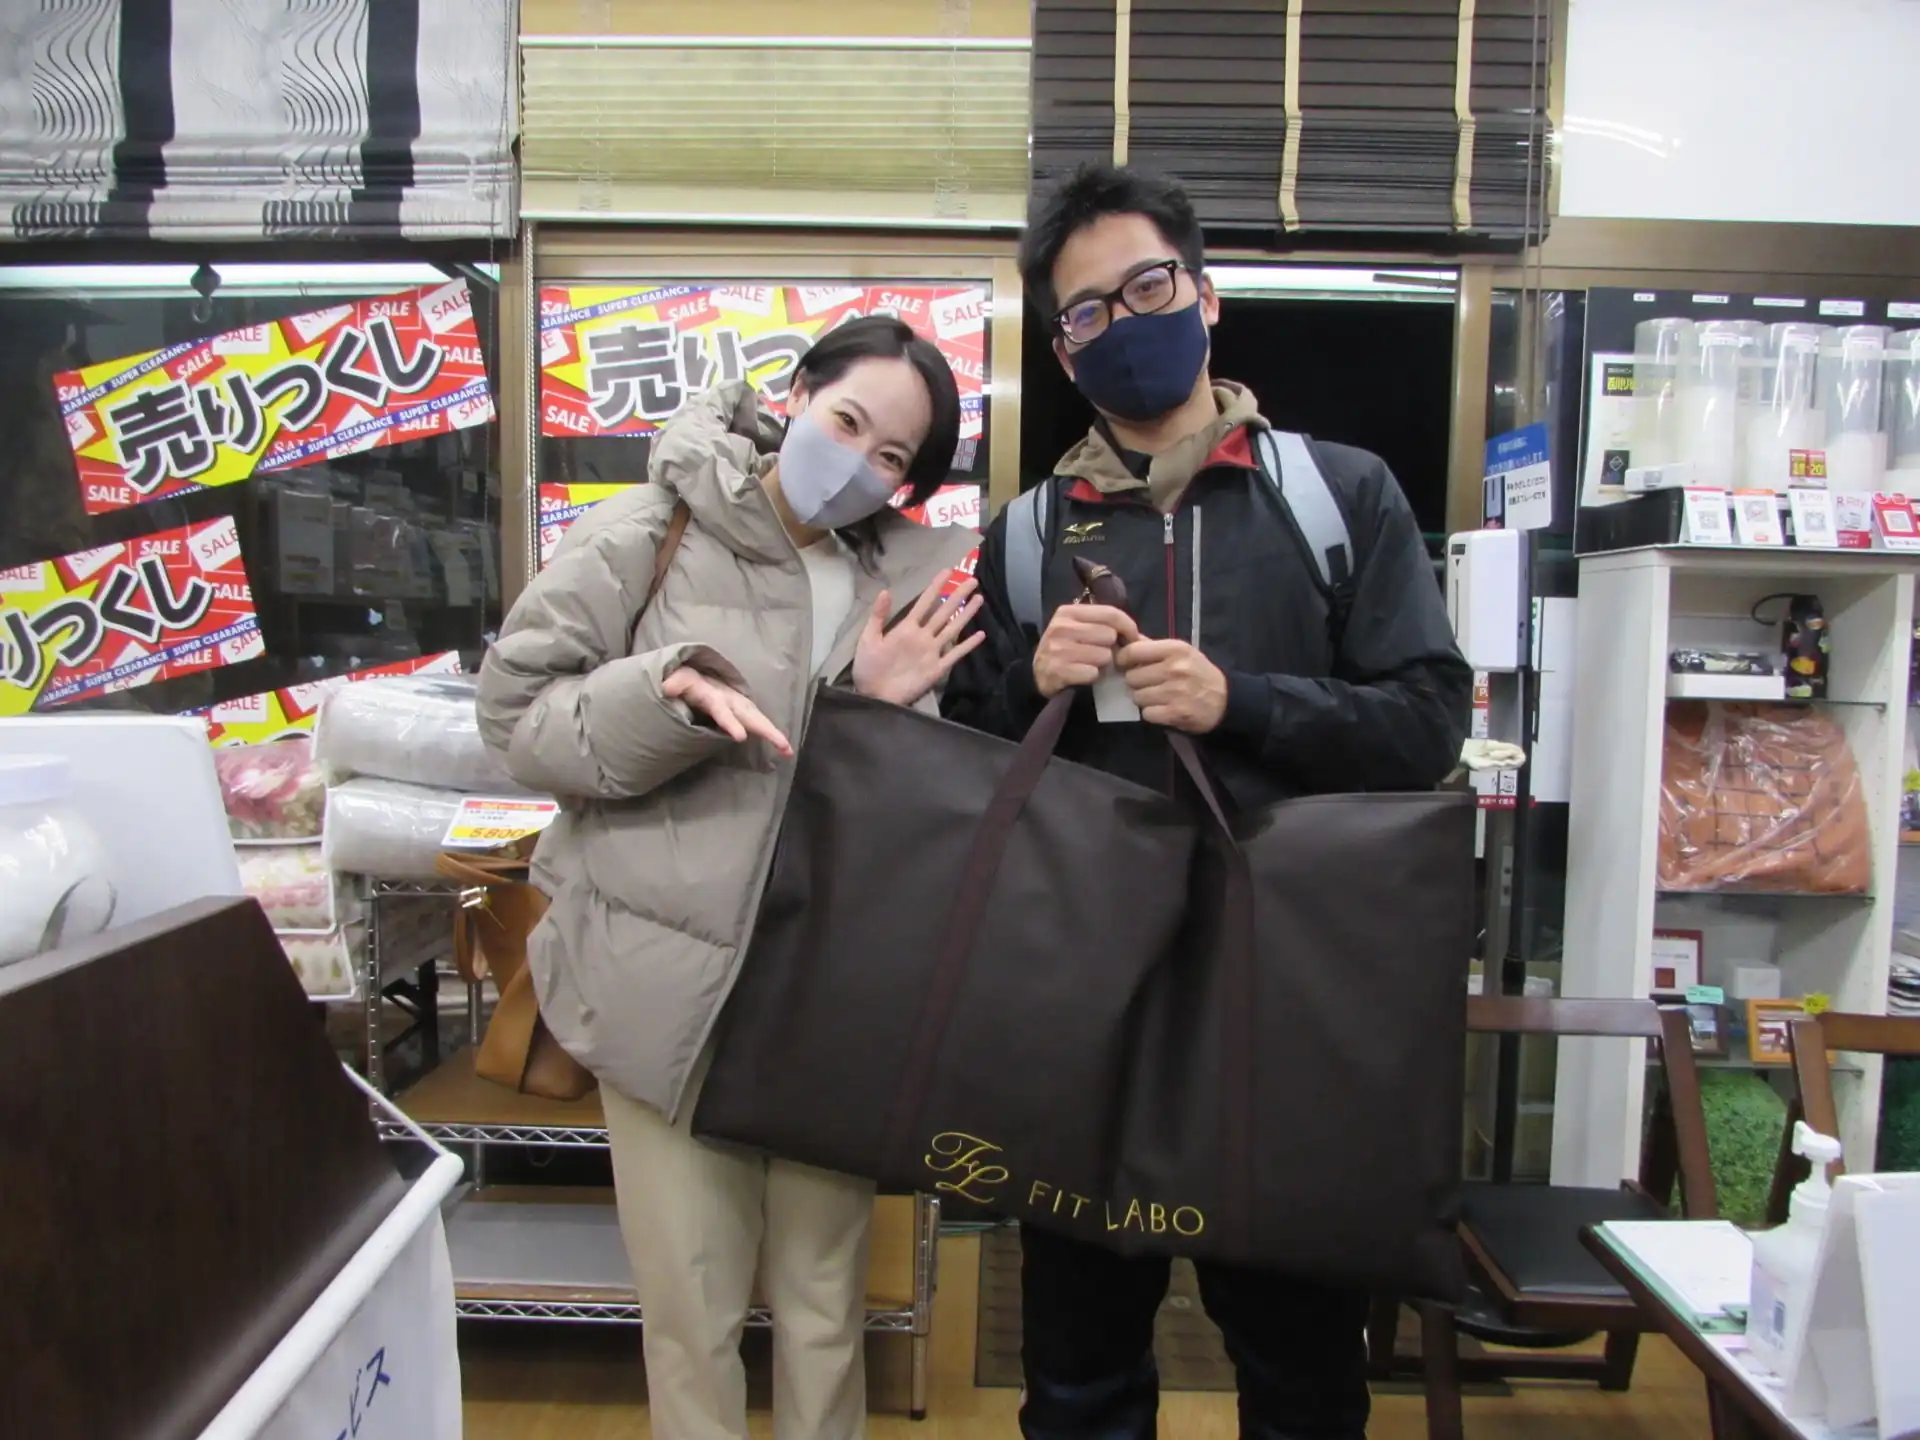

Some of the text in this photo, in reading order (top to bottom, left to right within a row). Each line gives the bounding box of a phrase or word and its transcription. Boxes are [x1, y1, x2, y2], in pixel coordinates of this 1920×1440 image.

[368, 301, 411, 317] SALE
[431, 287, 472, 322] SALE
[542, 286, 690, 328] EARANCE SUPER CLEARANCE
[668, 297, 709, 322] SALE
[878, 292, 923, 314] SALE
[943, 301, 984, 326] SALE
[62, 341, 193, 414] EARANCE SUPER CLEARANCE
[176, 347, 213, 380] SALE
[105, 314, 446, 494] 売りつくし
[307, 433, 337, 453] SUPER
[337, 415, 393, 441] CLEARANCE
[398, 403, 430, 421] SUPER
[430, 383, 487, 410] CLEARANCE
[545, 405, 591, 433] SALE
[88, 485, 131, 503] SALE
[938, 498, 980, 523] SALE
[140, 540, 181, 555] SALE
[201, 526, 239, 559] SALE
[85, 670, 113, 689] SUPER
[114, 651, 169, 678] CLEARANCE
[173, 639, 202, 657] SUPER
[203, 620, 256, 645] CLEARANCE
[1027, 1179, 1205, 1236] FIT LABO
[335, 1346, 391, 1440] ビス
